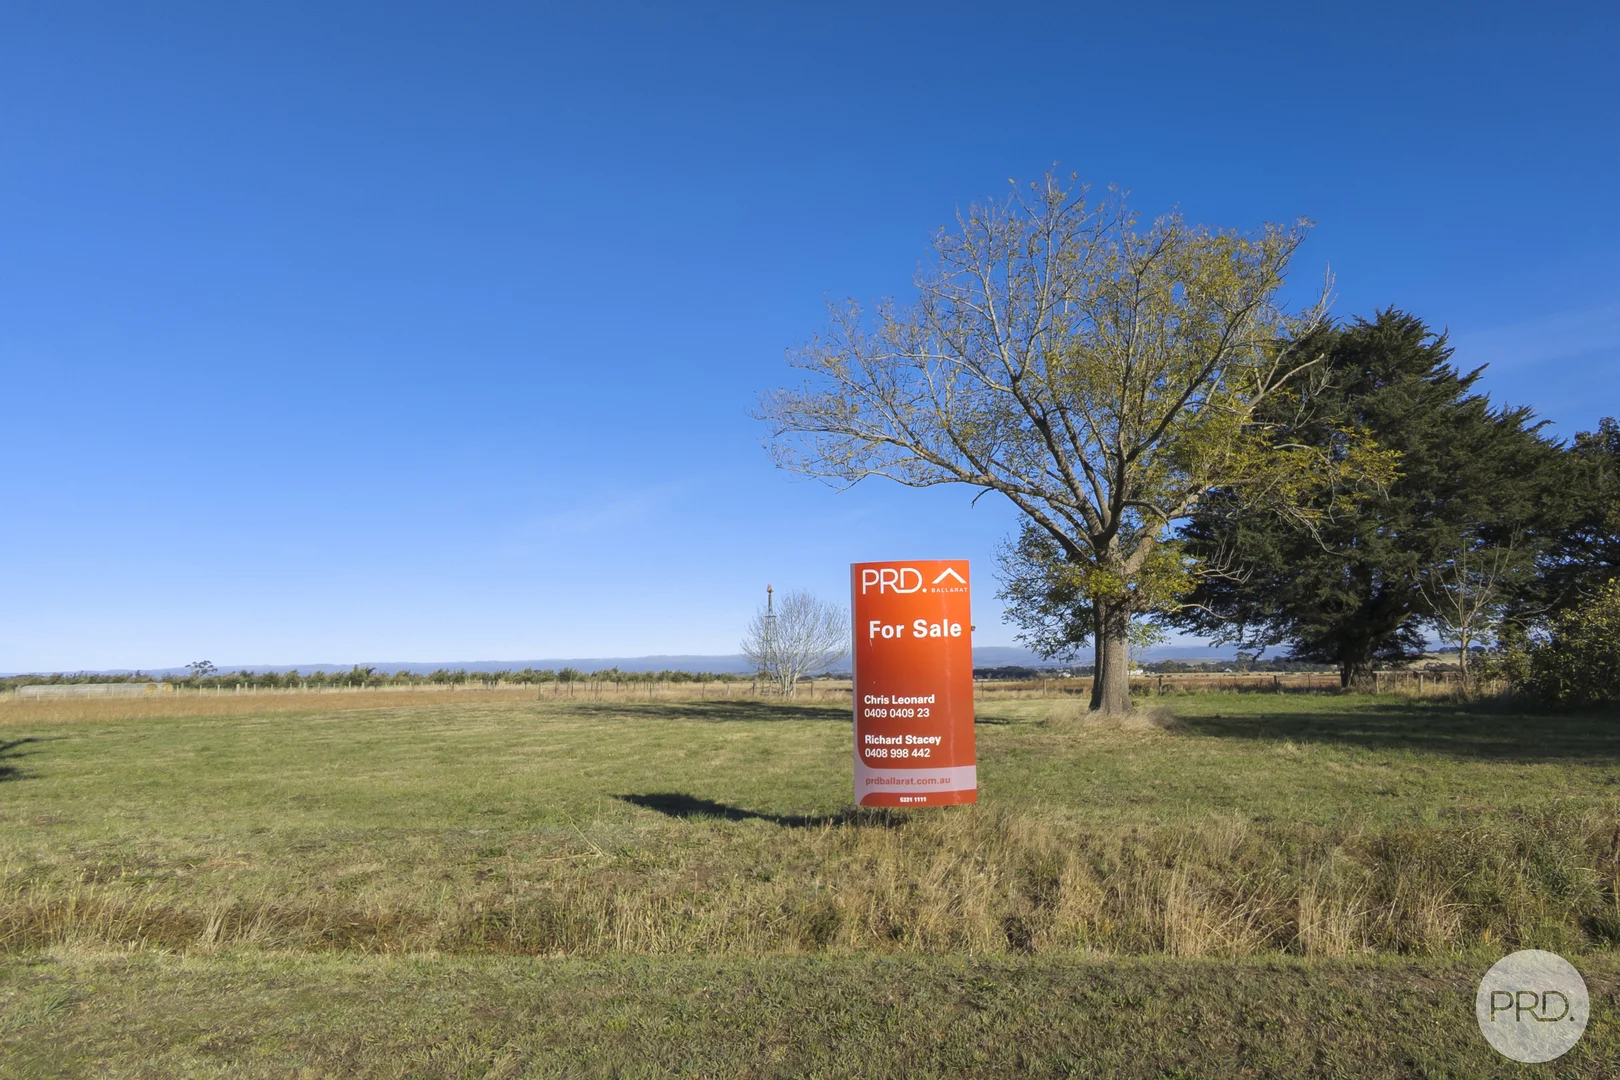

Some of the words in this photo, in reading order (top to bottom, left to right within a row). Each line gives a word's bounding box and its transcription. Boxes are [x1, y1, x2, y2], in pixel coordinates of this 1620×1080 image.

[862, 567, 927, 595] PRD.
[869, 620, 905, 639] For
[912, 618, 962, 639] Sale
[864, 694, 890, 705] Chris
[891, 693, 935, 705] Leonard
[864, 708, 887, 718] 0409
[889, 708, 914, 718] 0409
[917, 707, 930, 718] 23
[864, 734, 902, 745] Richard
[905, 734, 941, 745] Stacey
[864, 748, 888, 758] 0408
[890, 748, 909, 758] 998
[911, 748, 931, 758] 442
[865, 777, 951, 786] prdballarat.com.au
